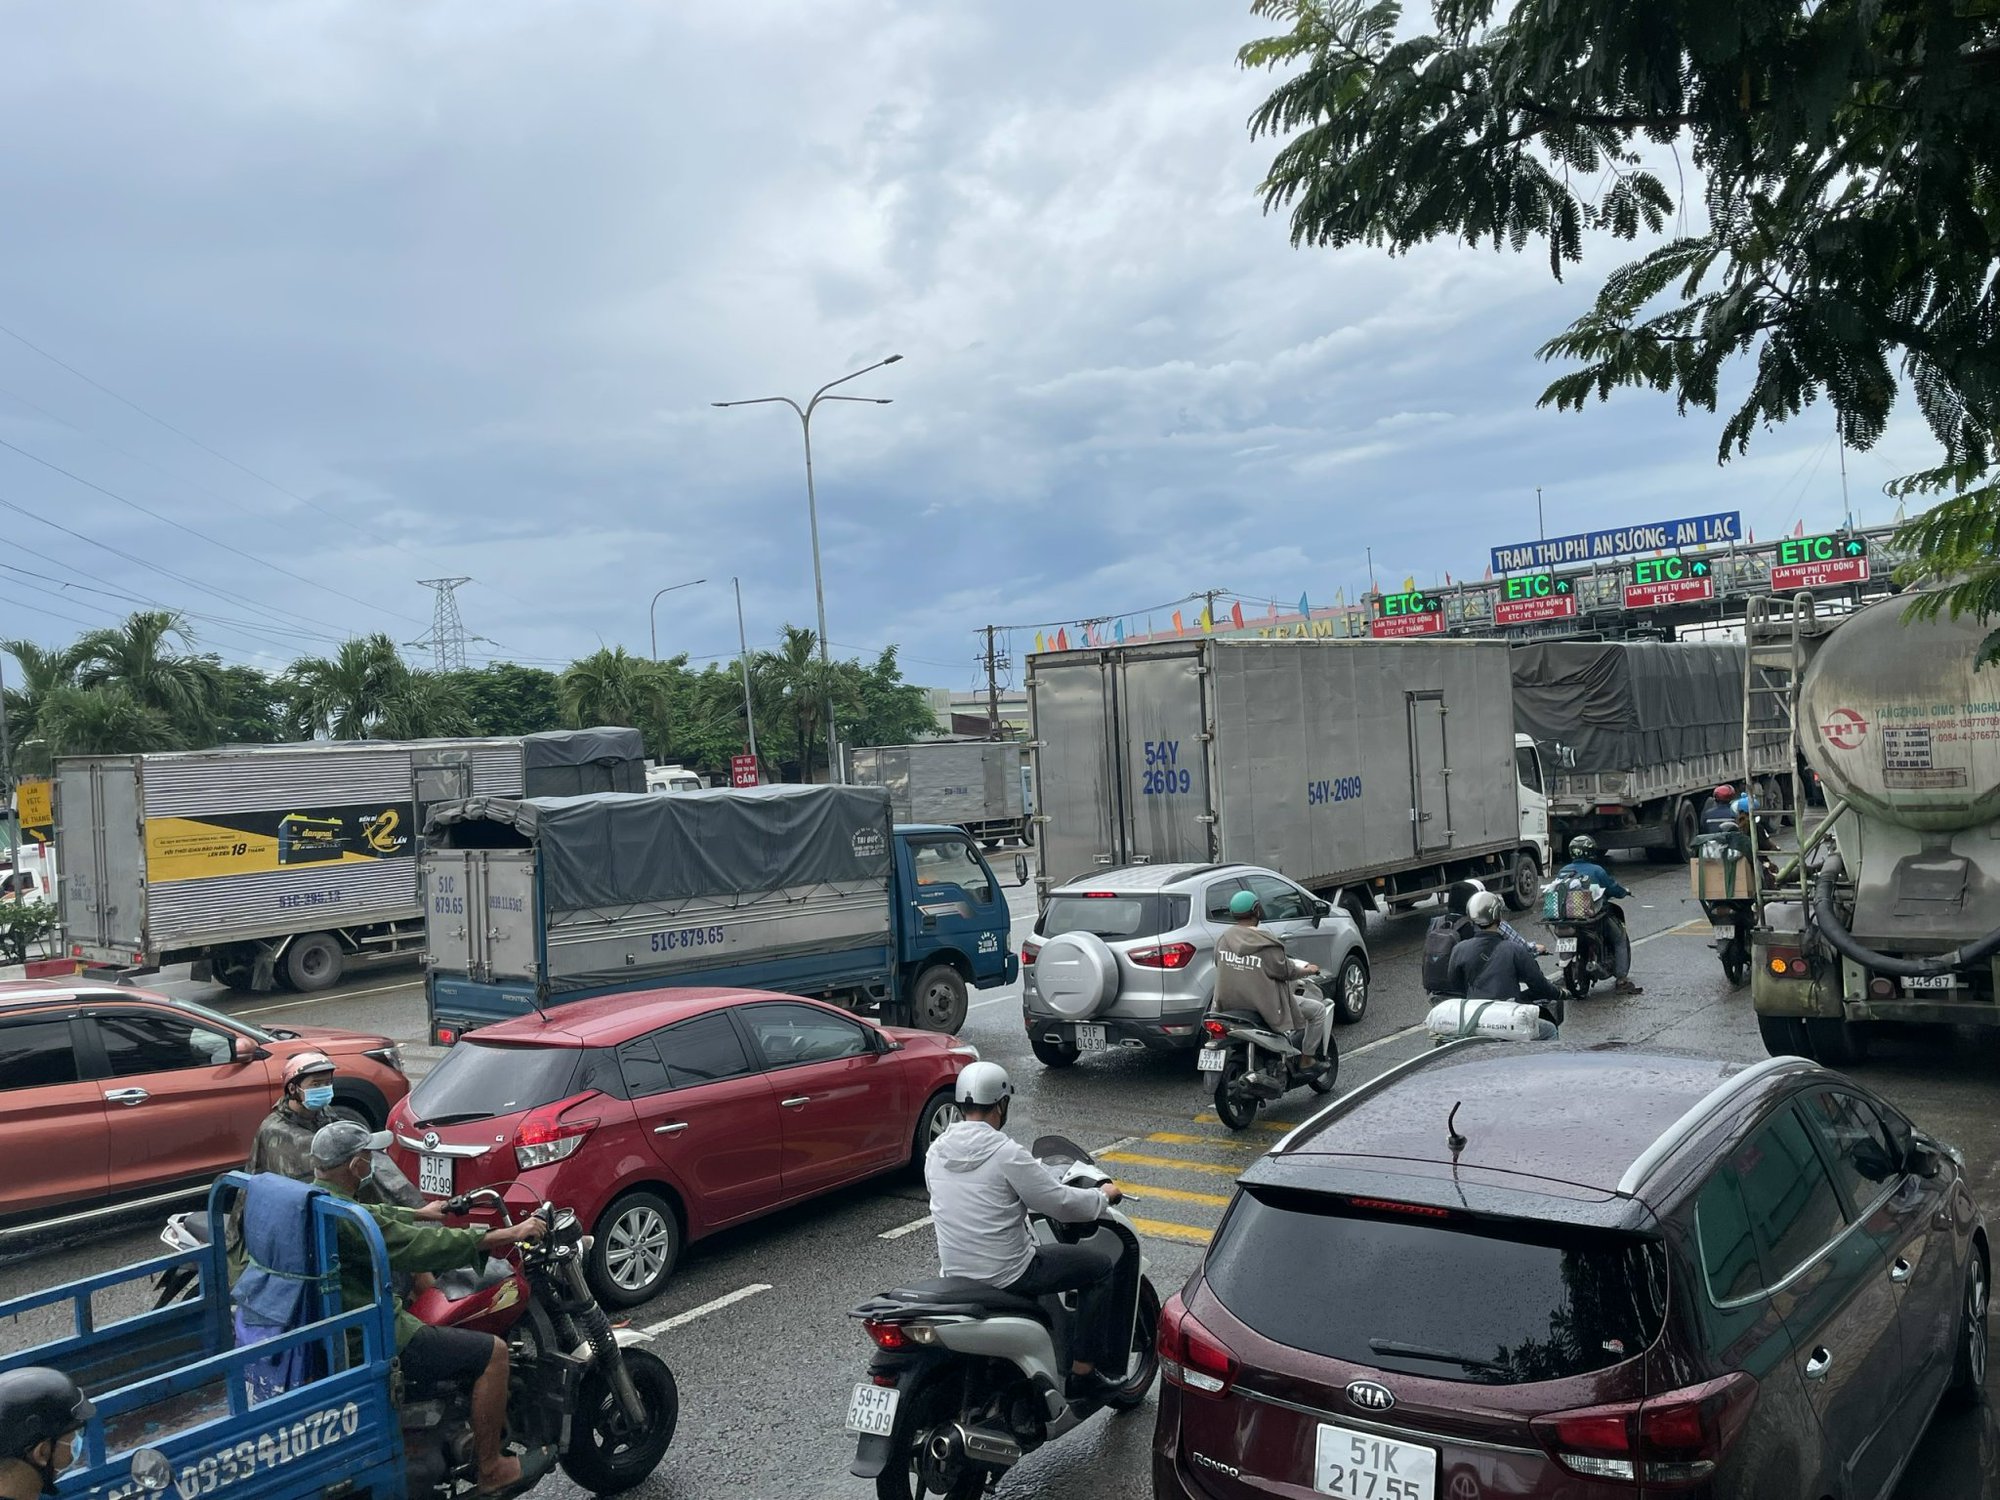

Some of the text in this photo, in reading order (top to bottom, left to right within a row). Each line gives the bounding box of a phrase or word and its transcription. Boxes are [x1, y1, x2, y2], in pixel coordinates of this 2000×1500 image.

[1496, 547, 1534, 570] TRẠM
[1536, 542, 1563, 564] THU
[1565, 534, 1589, 560] PHÍ
[1593, 534, 1614, 557] AN
[1676, 522, 1698, 544] AN
[1704, 517, 1735, 541] LẠC
[1781, 536, 1833, 564] ETC
[1636, 557, 1683, 584] ETC
[1792, 567, 1806, 577] THU
[1803, 574, 1827, 586] ETC
[1507, 575, 1550, 599] ETC
[1643, 585, 1657, 595] THU
[1653, 592, 1676, 604] ETC
[1385, 592, 1424, 616] ETC
[1512, 603, 1524, 611] THU
[1144, 741, 1179, 766] 54Y
[736, 771, 756, 785] CẤM
[1142, 769, 1191, 795] 2609
[1308, 775, 1363, 806] 54Y-2609
[231, 843, 247, 856] 18
[439, 876, 454, 893] 51C
[435, 897, 464, 914] 879.65
[1082, 1026, 1098, 1038] 51F
[427, 1157, 444, 1175] 51F
[420, 1174, 451, 1194] 373.99
[857, 1388, 891, 1411] 59-F1
[1353, 1385, 1387, 1408] KIA
[850, 1407, 891, 1431] 345.09
[181, 1402, 360, 1500] 0939410720
[1350, 1436, 1400, 1475] 51K
[1192, 1451, 1239, 1477] RONDO
